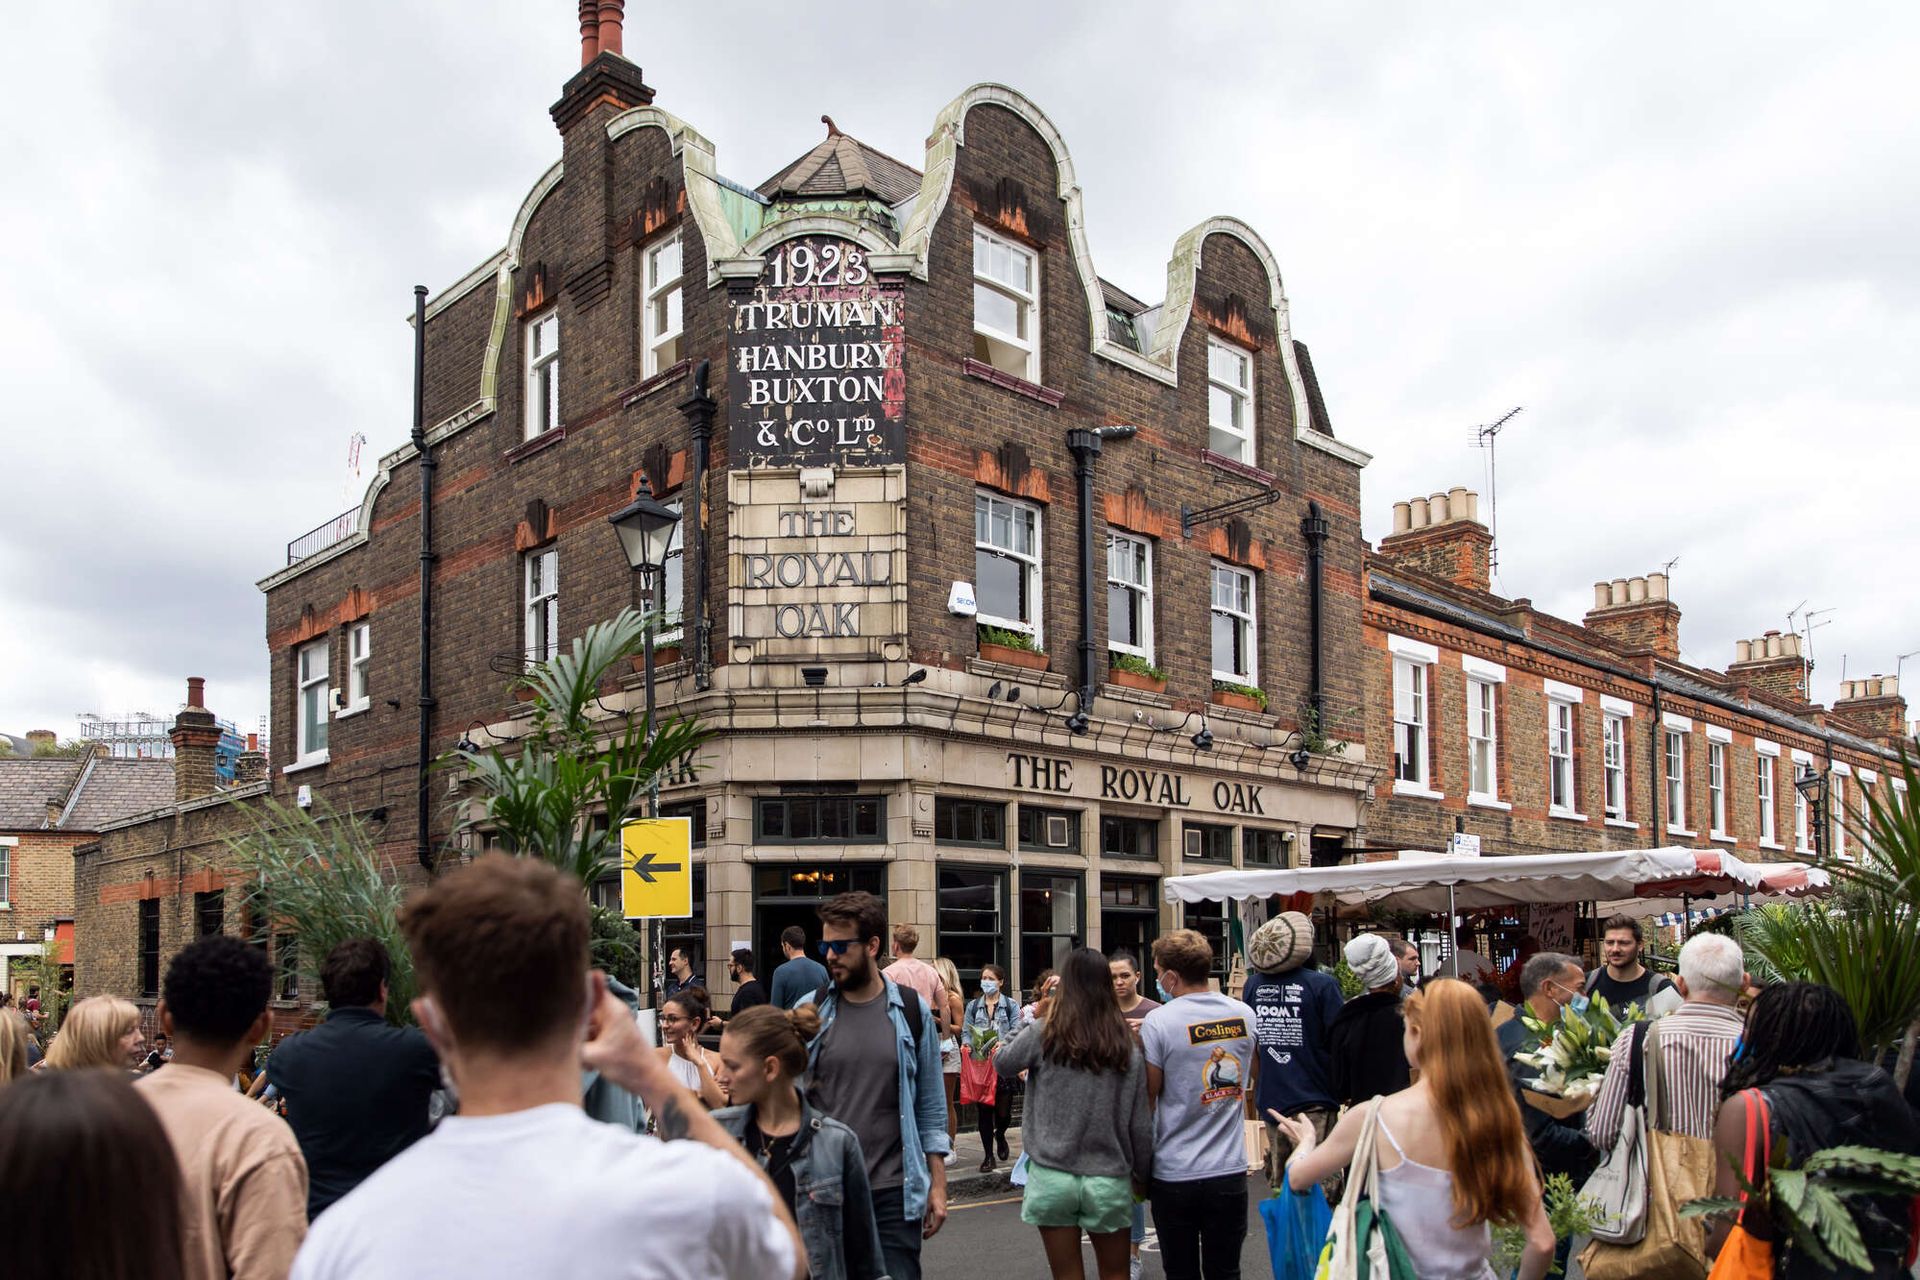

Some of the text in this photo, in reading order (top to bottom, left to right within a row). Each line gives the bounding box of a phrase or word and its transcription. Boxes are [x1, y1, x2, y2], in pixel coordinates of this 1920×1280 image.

[770, 245, 868, 287] 1923
[740, 301, 893, 331] TRUMAN
[739, 343, 893, 372] HANBURY
[749, 375, 885, 405] BUXTON
[757, 420, 779, 446] &
[780, 510, 854, 537] THE
[745, 552, 890, 588] ROYAL
[776, 603, 861, 638] OAK
[1006, 753, 1265, 815] THE ROYAL OAK
[1256, 1005, 1291, 1017] SOOM
[1194, 1021, 1242, 1039] Goslings
